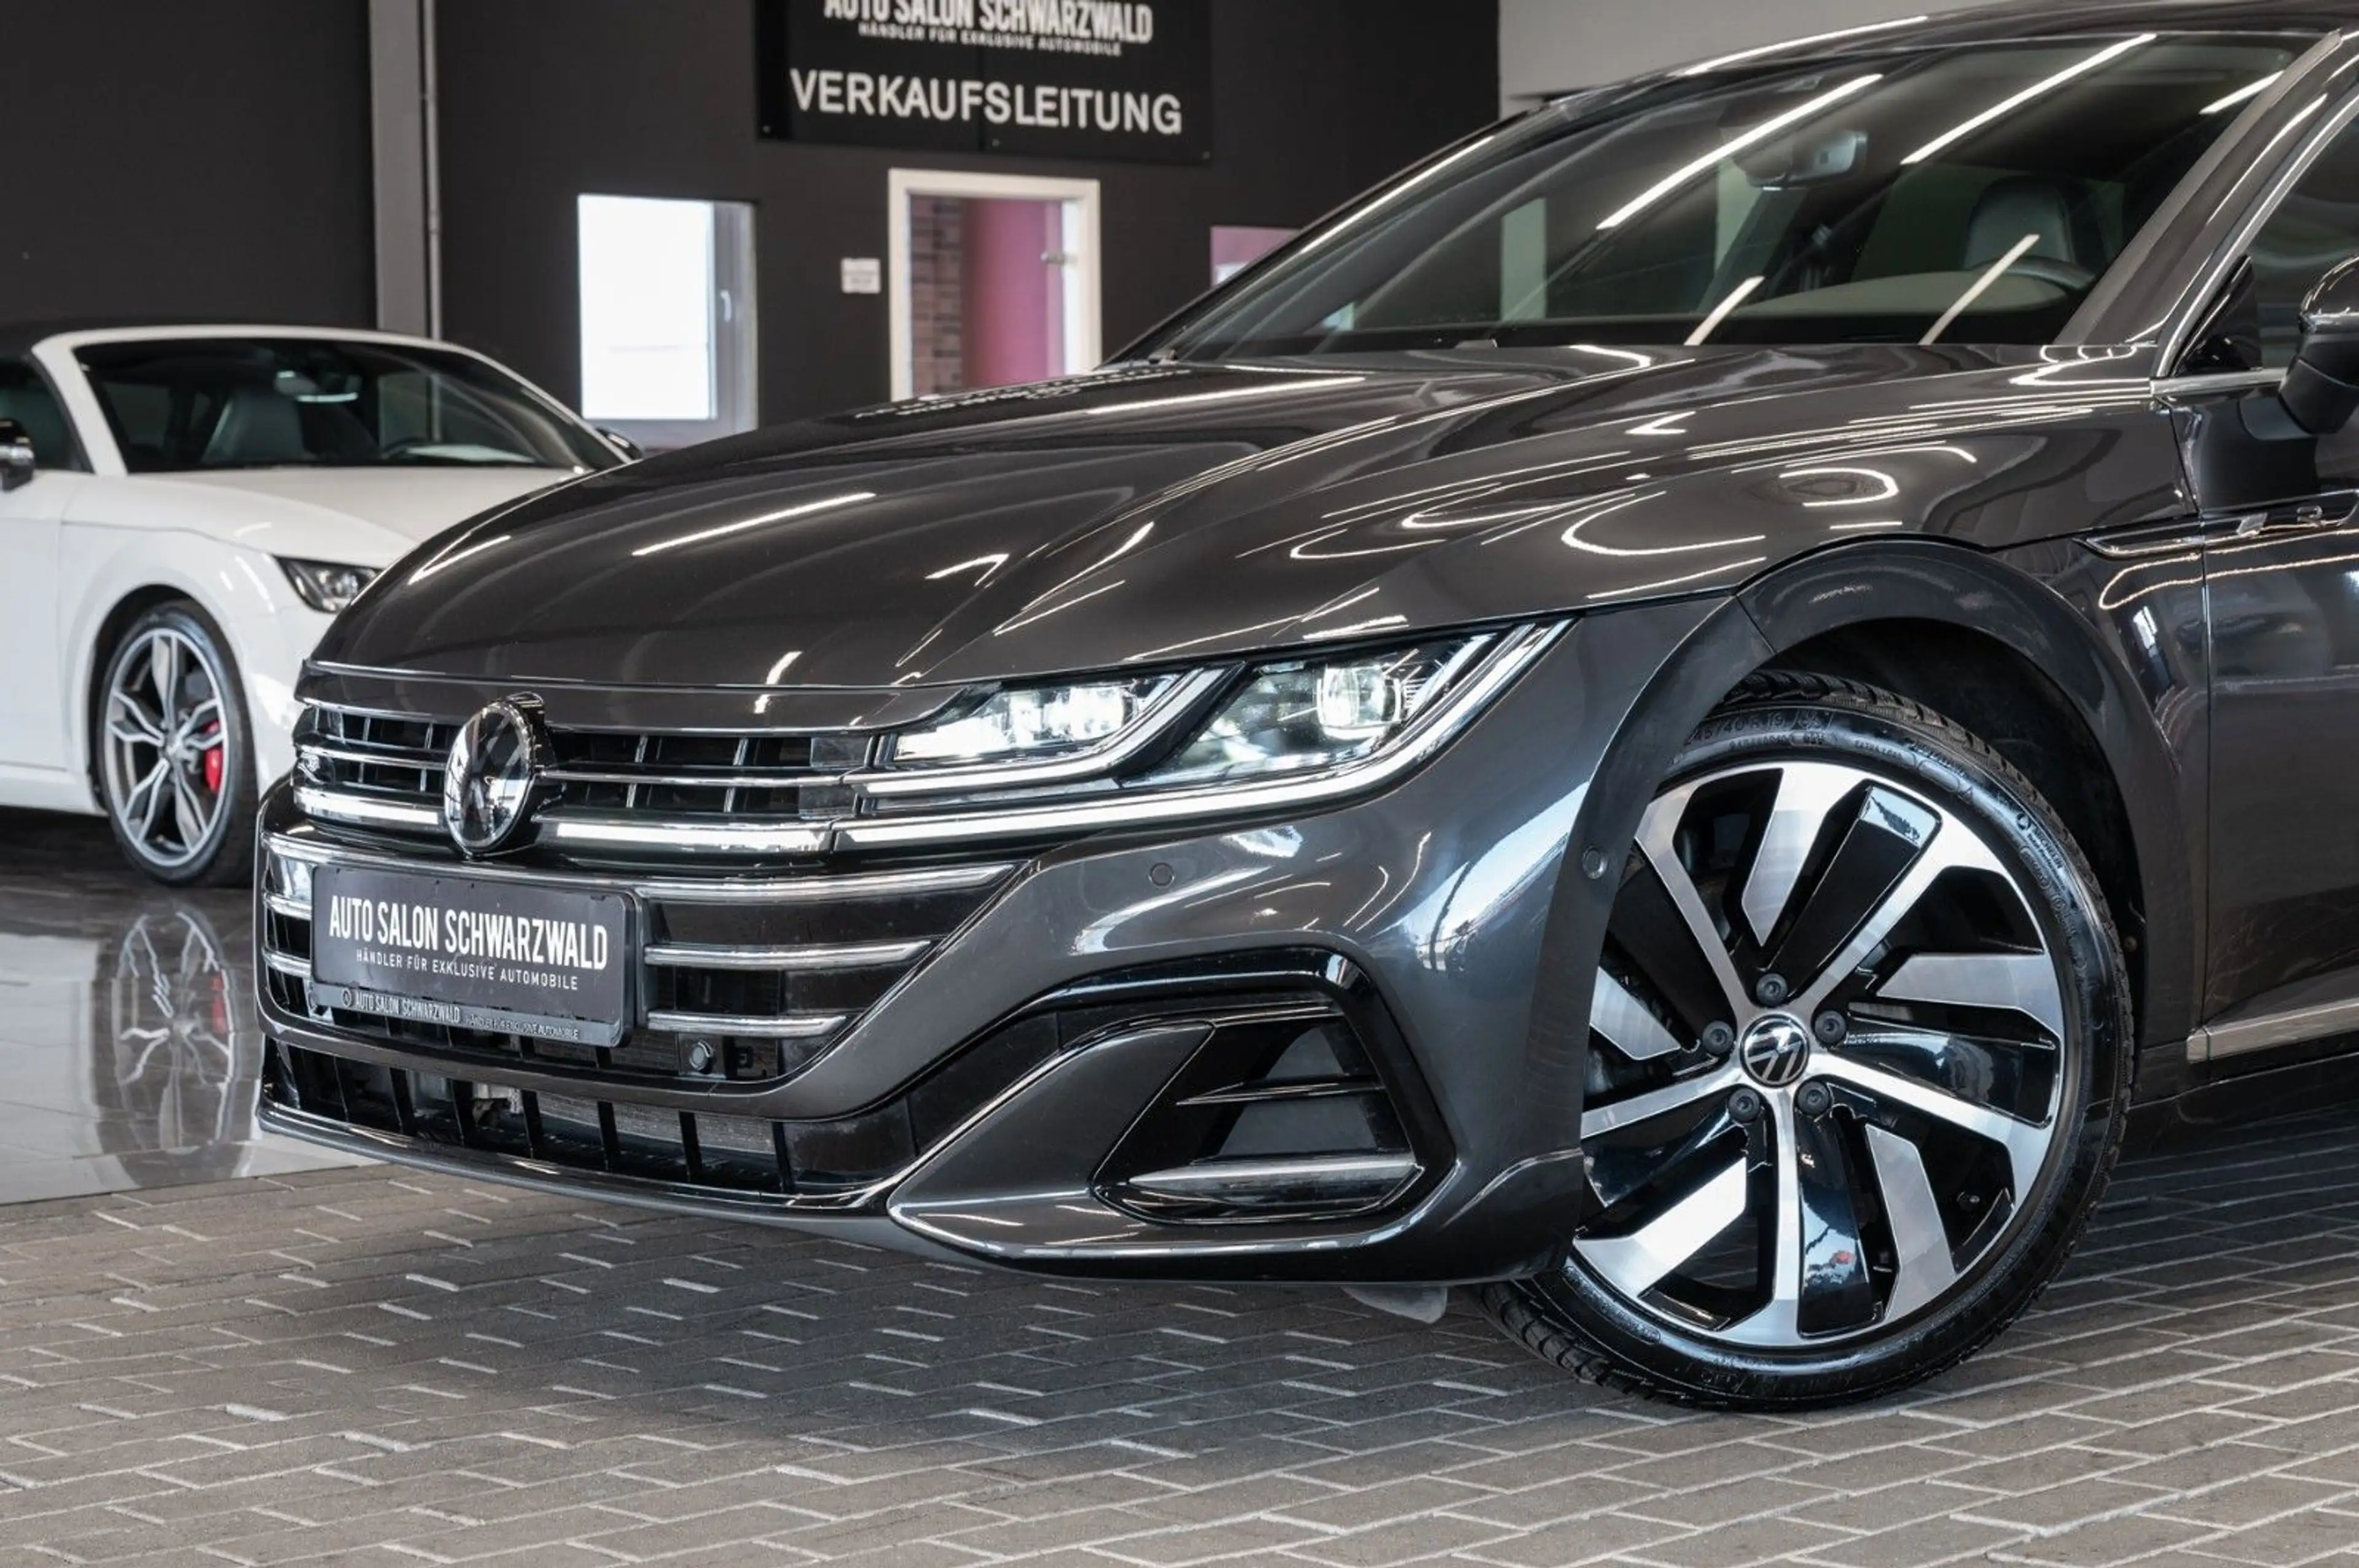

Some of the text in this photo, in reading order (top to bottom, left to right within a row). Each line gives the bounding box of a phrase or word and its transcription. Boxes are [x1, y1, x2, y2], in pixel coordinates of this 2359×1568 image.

[979, 0, 1152, 44] SCHWARZWALD
[790, 68, 1182, 135] VERKAUFSLEITUNG
[328, 895, 608, 971] AUTO SALON SCHWARZWALD
[356, 947, 578, 991] HÄNDLER FÜR EXKLUSIVE AUTOMOBILE
[356, 991, 460, 1024] AUTO SALON SCHWARZWALD
